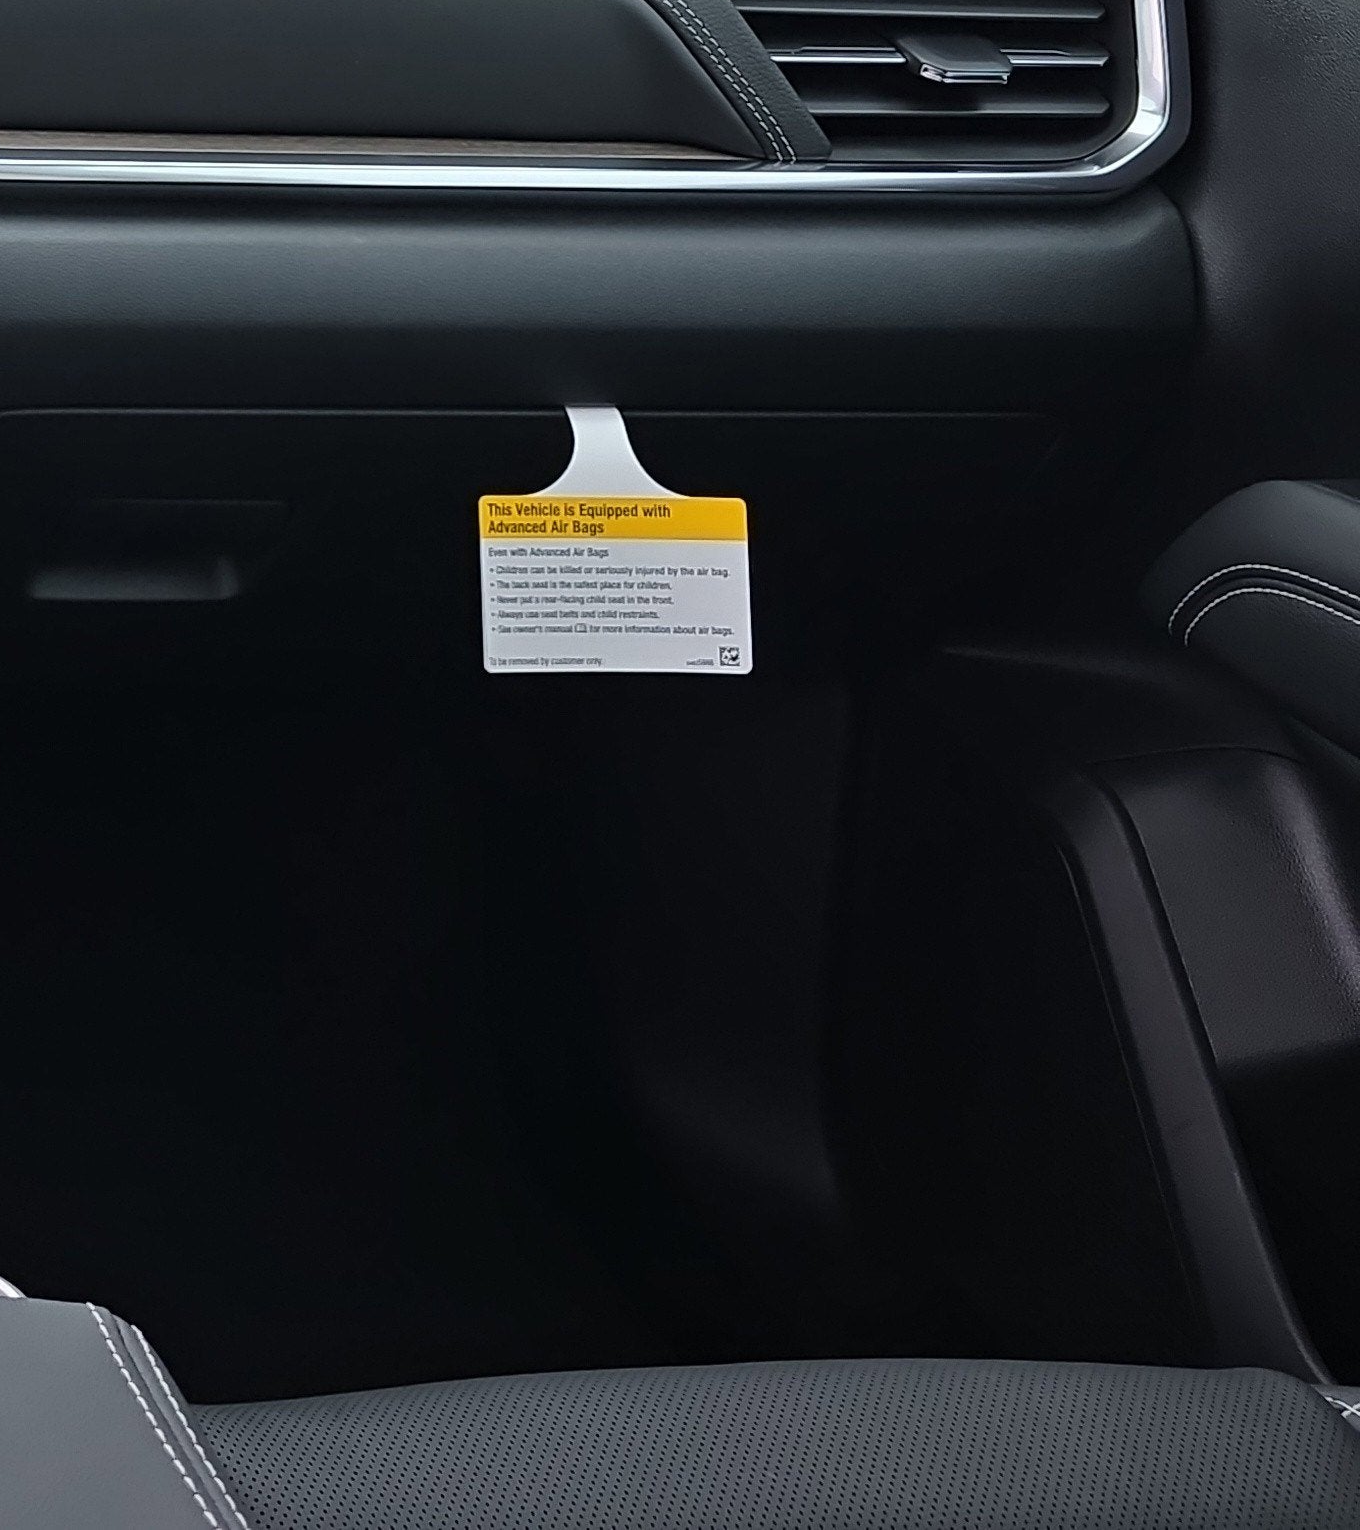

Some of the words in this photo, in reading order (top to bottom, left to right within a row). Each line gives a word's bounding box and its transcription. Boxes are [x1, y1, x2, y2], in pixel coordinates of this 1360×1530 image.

[487, 503, 512, 517] This
[515, 503, 560, 517] Vehicle
[580, 504, 638, 520] Equipped
[642, 504, 671, 518] with
[488, 520, 547, 534] Advanced
[551, 521, 567, 534] Air
[573, 522, 605, 536] Bags
[488, 547, 507, 557] Even
[510, 548, 527, 557] with
[530, 547, 571, 557] Advanced
[573, 548, 585, 557] Air
[587, 547, 609, 559] Bags
[496, 565, 528, 574] Children
[547, 566, 557, 574] be
[559, 566, 582, 574] killed
[595, 566, 633, 576] seriously
[635, 567, 665, 576] injured
[667, 567, 678, 577] by
[680, 568, 694, 576] the
[697, 567, 709, 576] air
[711, 568, 731, 578] bag.
[600, 582, 621, 590] place
[623, 581, 634, 589] for
[541, 596, 584, 605] rear-facing
[586, 596, 605, 604] child
[637, 596, 650, 604] the
[652, 596, 674, 604] front.
[597, 611, 617, 619] child
[625, 625, 670, 634] information
[673, 626, 696, 634] about
[698, 626, 709, 634] air
[711, 626, 734, 636] bags.
